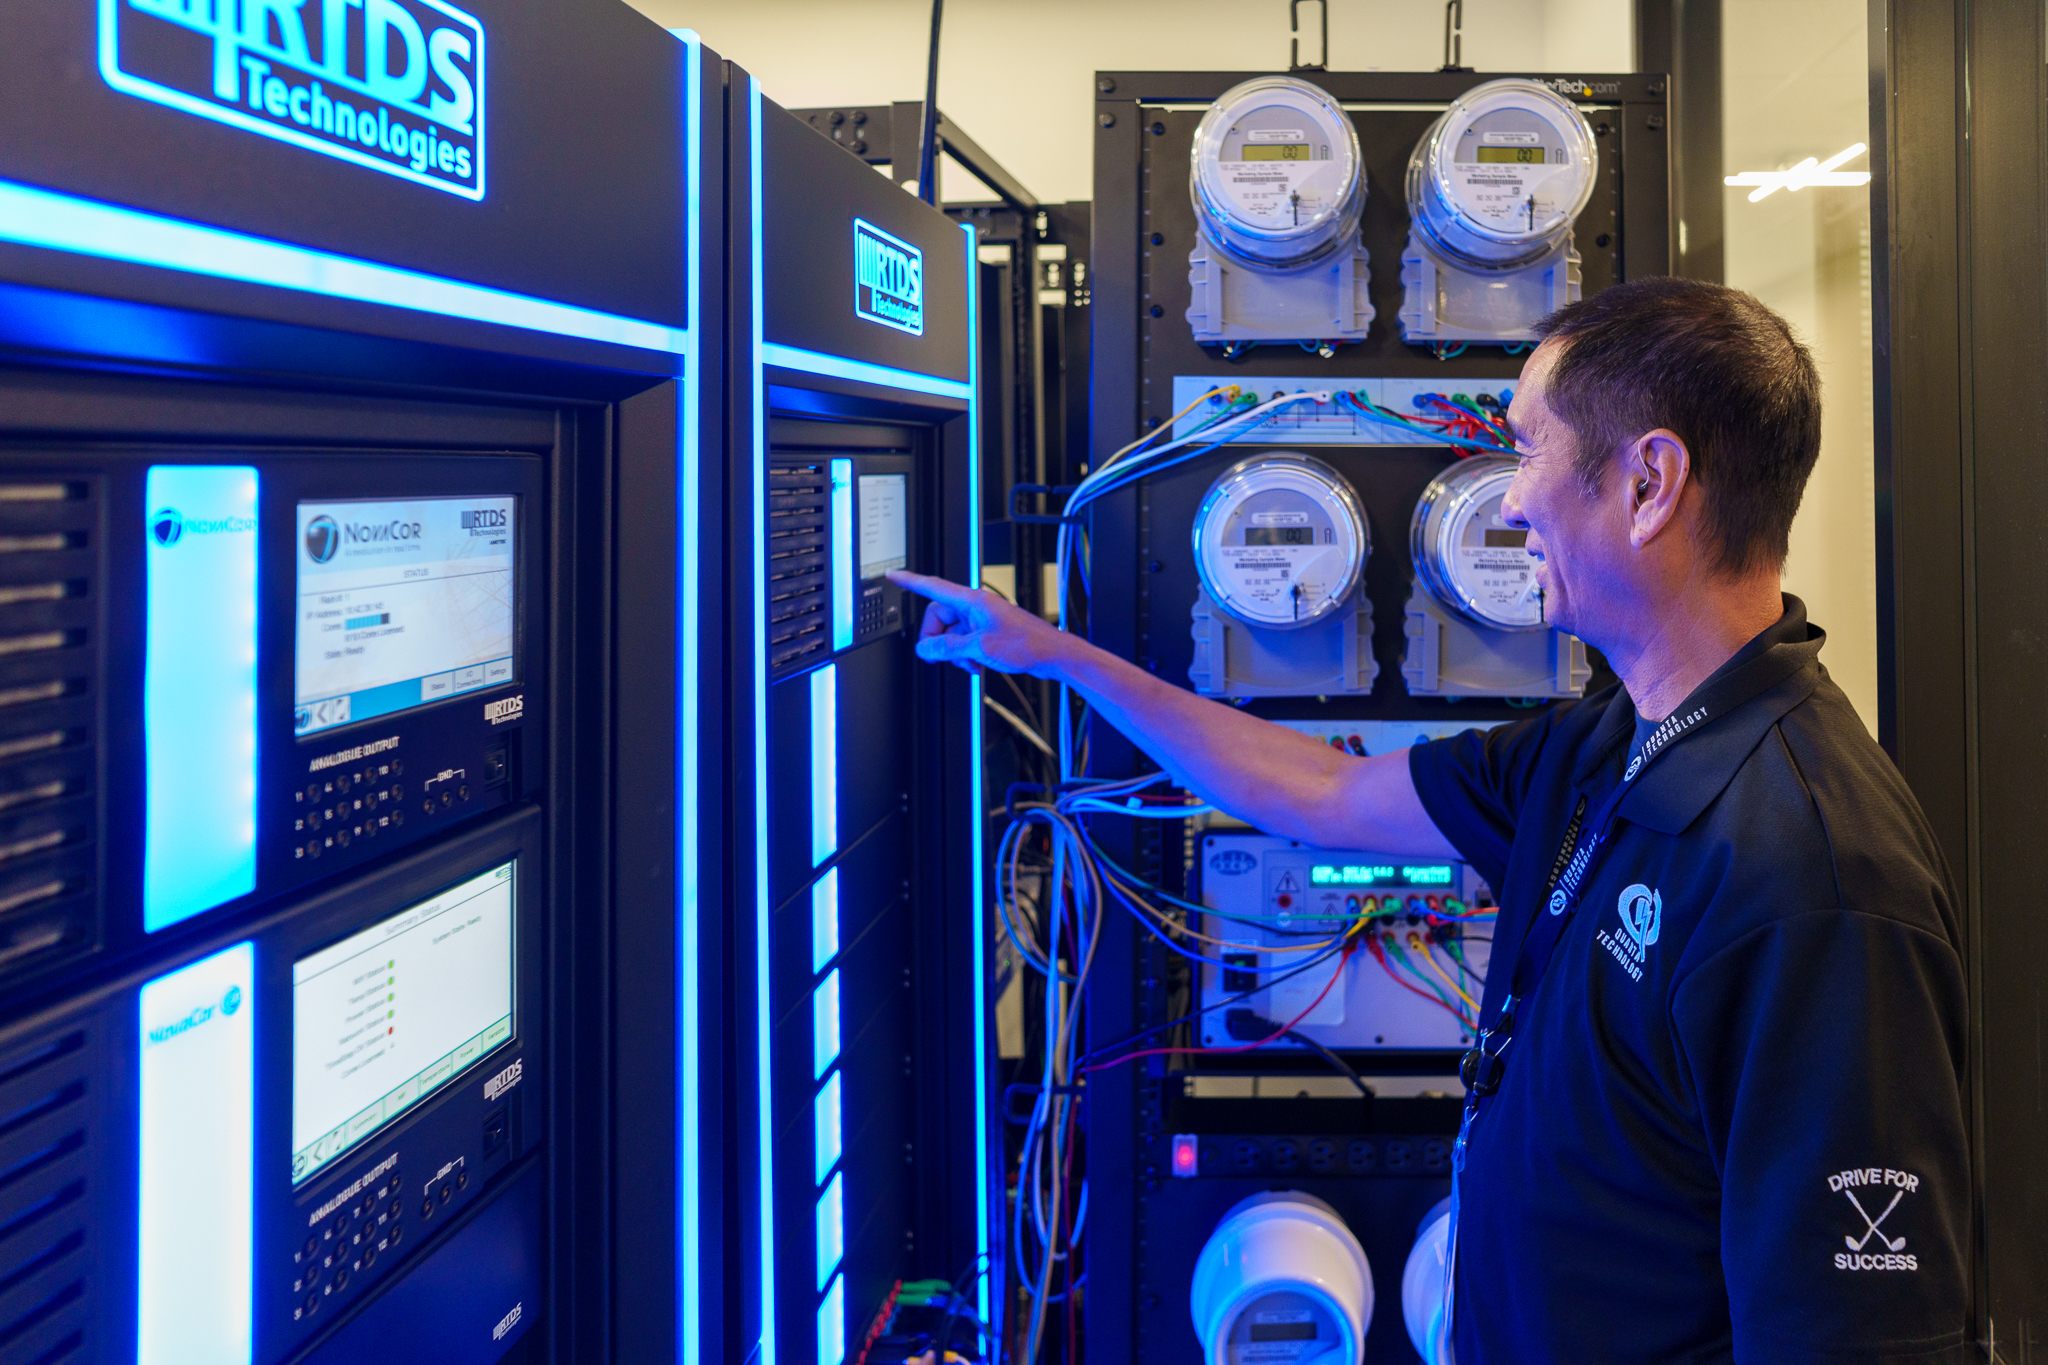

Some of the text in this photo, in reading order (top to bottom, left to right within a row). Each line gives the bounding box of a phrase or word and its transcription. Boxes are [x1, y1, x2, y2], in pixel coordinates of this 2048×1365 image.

[239, 53, 472, 179] Technologies
[876, 240, 920, 306] RTDS
[473, 509, 506, 527] RTDS
[495, 695, 523, 717] RTDS
[1646, 715, 1677, 749] QUANTA
[1647, 706, 1708, 756] TECHNOLOGY
[1548, 823, 1574, 888] TECHNOLOGY
[1563, 847, 1585, 883] QUANTA
[1568, 832, 1598, 890] TECHNOLOGY
[1596, 929, 1643, 982] TECHNOLOGY
[1614, 928, 1641, 962] QUANTA
[494, 1058, 522, 1090] RTDS
[1827, 1167, 1919, 1193] DRIVE FOR
[1834, 1253, 1918, 1271] SUCCESS
